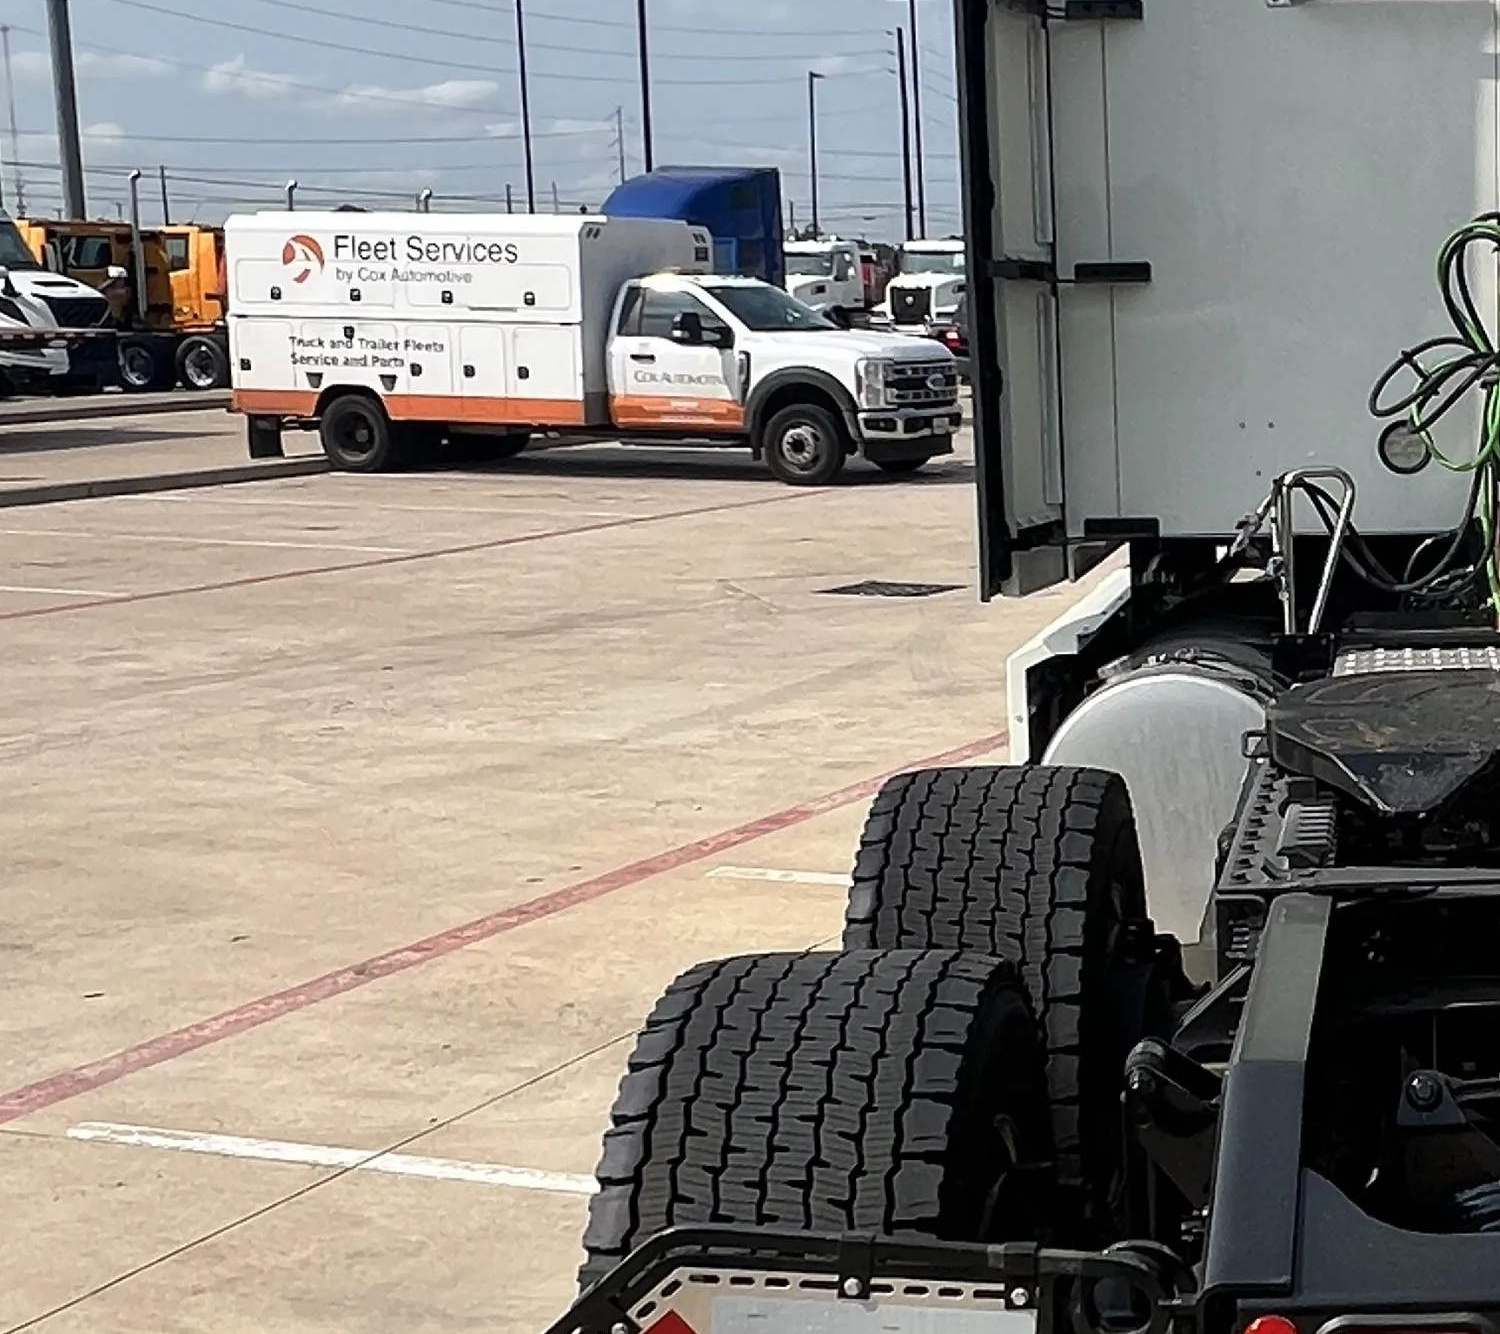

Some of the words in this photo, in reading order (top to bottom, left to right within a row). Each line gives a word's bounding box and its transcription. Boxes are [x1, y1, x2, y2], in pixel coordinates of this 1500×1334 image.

[334, 234, 397, 261] Fleet
[406, 235, 518, 264] Services
[335, 267, 353, 283] by
[357, 267, 386, 282] Cox
[391, 267, 473, 284] Automotive
[289, 336, 325, 348] Truck
[330, 338, 353, 349] and
[358, 338, 400, 351] Trailer
[403, 339, 444, 352] Fleets
[290, 352, 338, 366] Service
[343, 353, 367, 367] and
[371, 355, 405, 367] Parts
